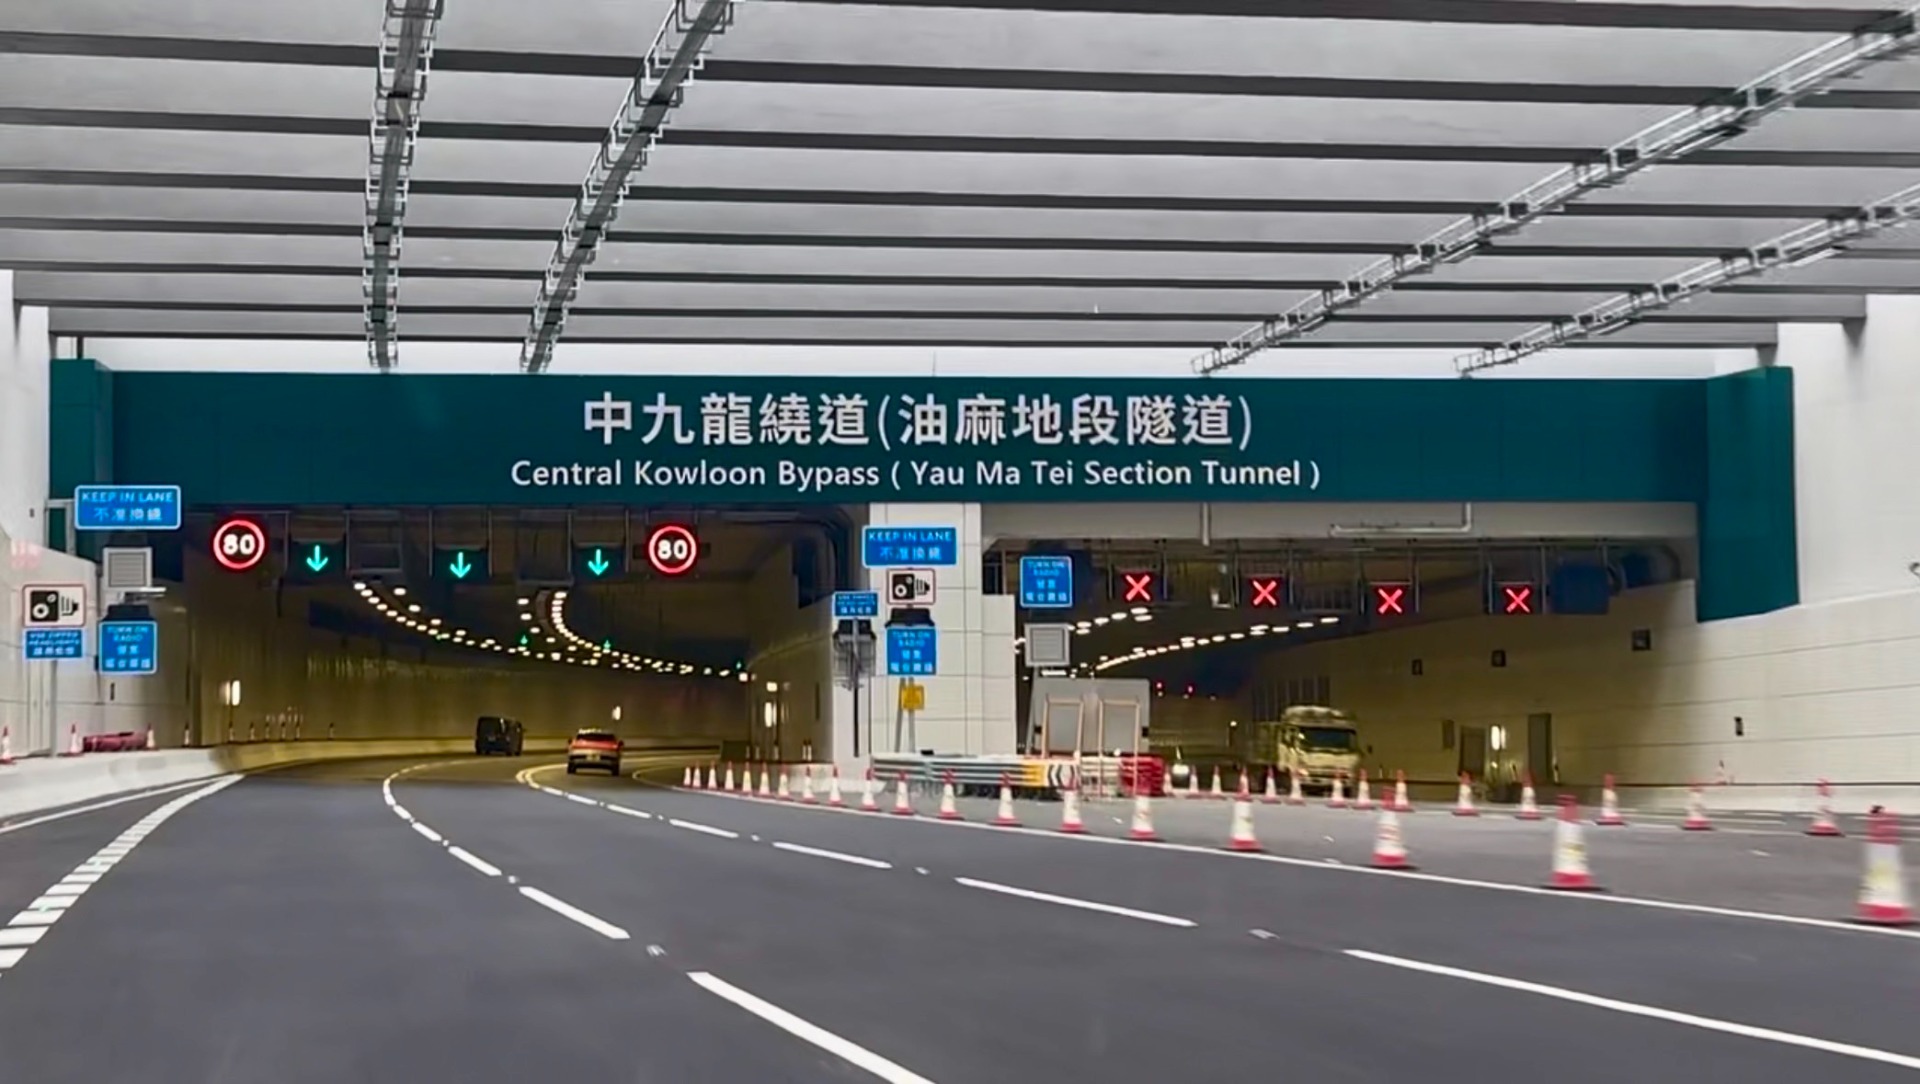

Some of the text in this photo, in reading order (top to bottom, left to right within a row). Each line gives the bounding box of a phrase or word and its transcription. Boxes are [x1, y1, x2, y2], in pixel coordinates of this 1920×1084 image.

[585, 391, 1253, 451] 中九龍繞道(油麻地段隧道)
[511, 459, 621, 486] Central
[635, 459, 766, 486] Kowloon
[779, 460, 880, 492] Bypass
[976, 461, 1020, 485] Ma
[1031, 460, 1073, 485] Tei
[1085, 460, 1192, 485] Section
[82, 491, 173, 503] KEEP IN LANE
[224, 534, 255, 556] 80
[868, 531, 952, 542] KEEP IN LANE
[657, 538, 687, 561] 80
